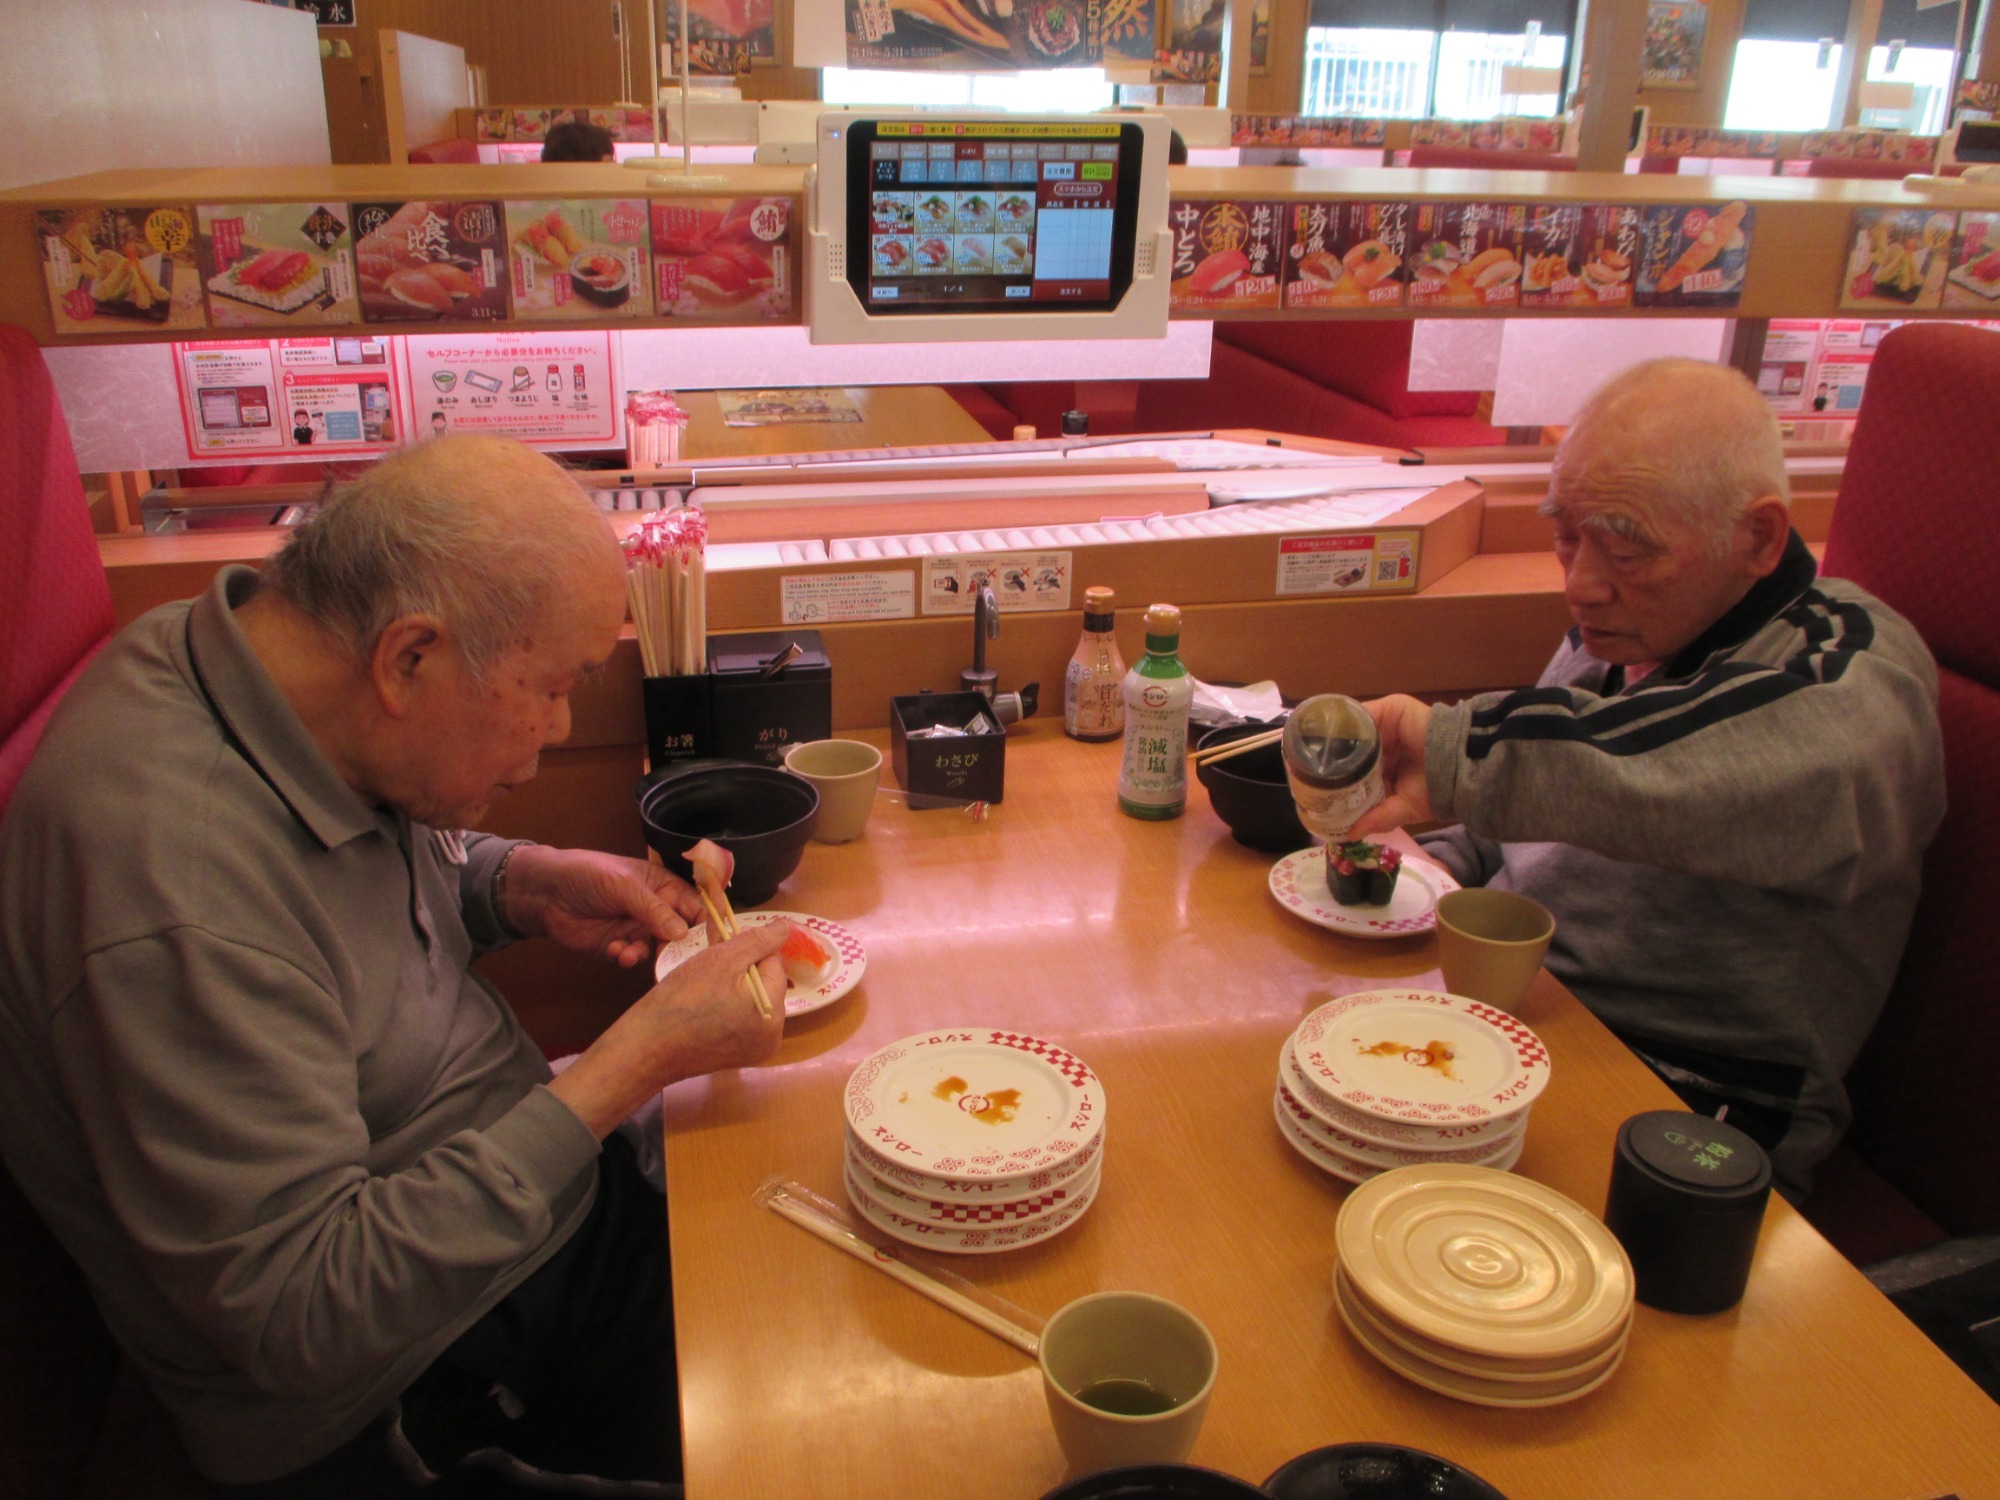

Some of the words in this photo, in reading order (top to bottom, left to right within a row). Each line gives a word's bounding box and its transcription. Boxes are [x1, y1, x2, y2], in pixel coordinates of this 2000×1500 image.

[1174, 203, 1200, 274] 中とろ
[286, 373, 295, 385] 3
[1142, 692, 1170, 701] スシロー
[664, 733, 695, 748] お箸
[758, 728, 788, 742] がり
[935, 753, 979, 768] わさび
[1147, 737, 1168, 774] 減塩
[1393, 992, 1455, 1006] スシロー
[915, 1033, 974, 1047] スシロー
[1307, 1051, 1341, 1085] スシロー
[1492, 1074, 1531, 1104] スシロー
[1070, 1093, 1093, 1132] スシロー
[1435, 1122, 1490, 1139] スシロー
[871, 1125, 923, 1157] スシロー
[940, 1180, 1010, 1193] スシロー
